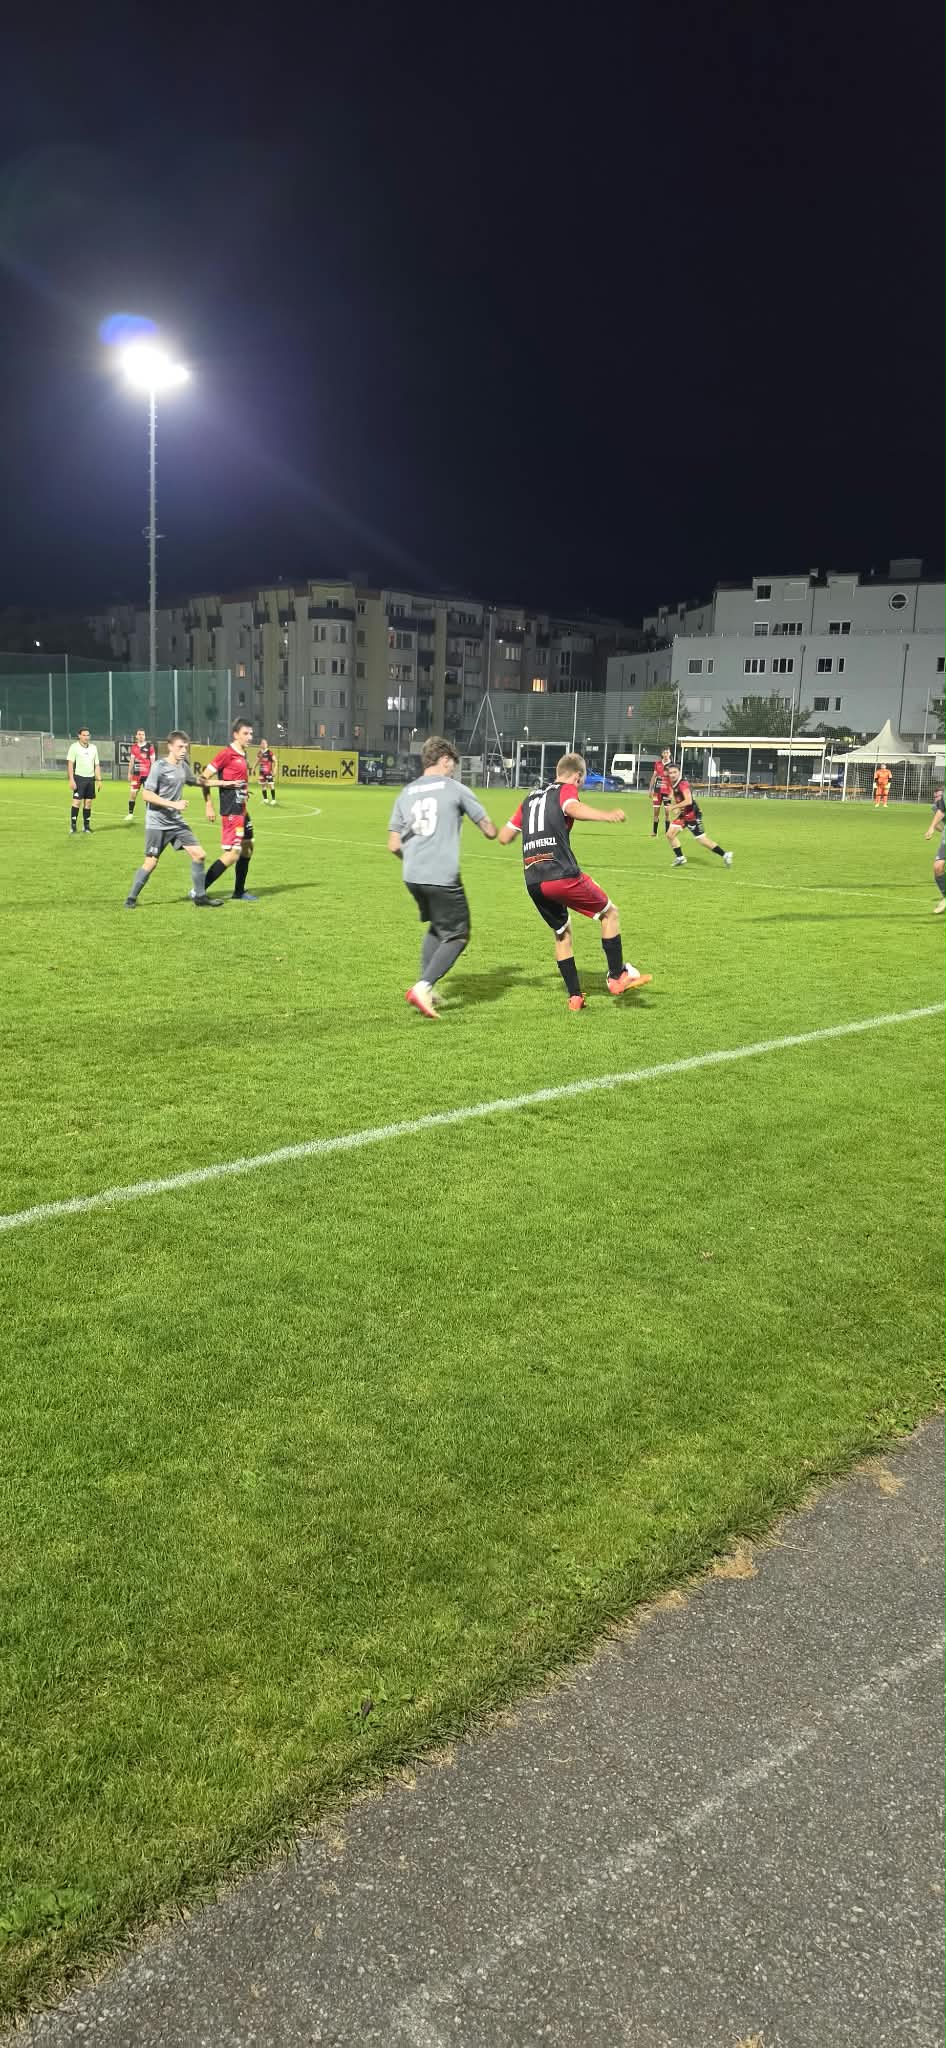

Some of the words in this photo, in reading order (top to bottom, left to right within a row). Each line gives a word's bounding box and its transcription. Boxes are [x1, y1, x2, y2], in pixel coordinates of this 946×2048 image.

[282, 764, 338, 779] Raiffeisen
[411, 797, 437, 836] 13
[528, 792, 547, 834] 11
